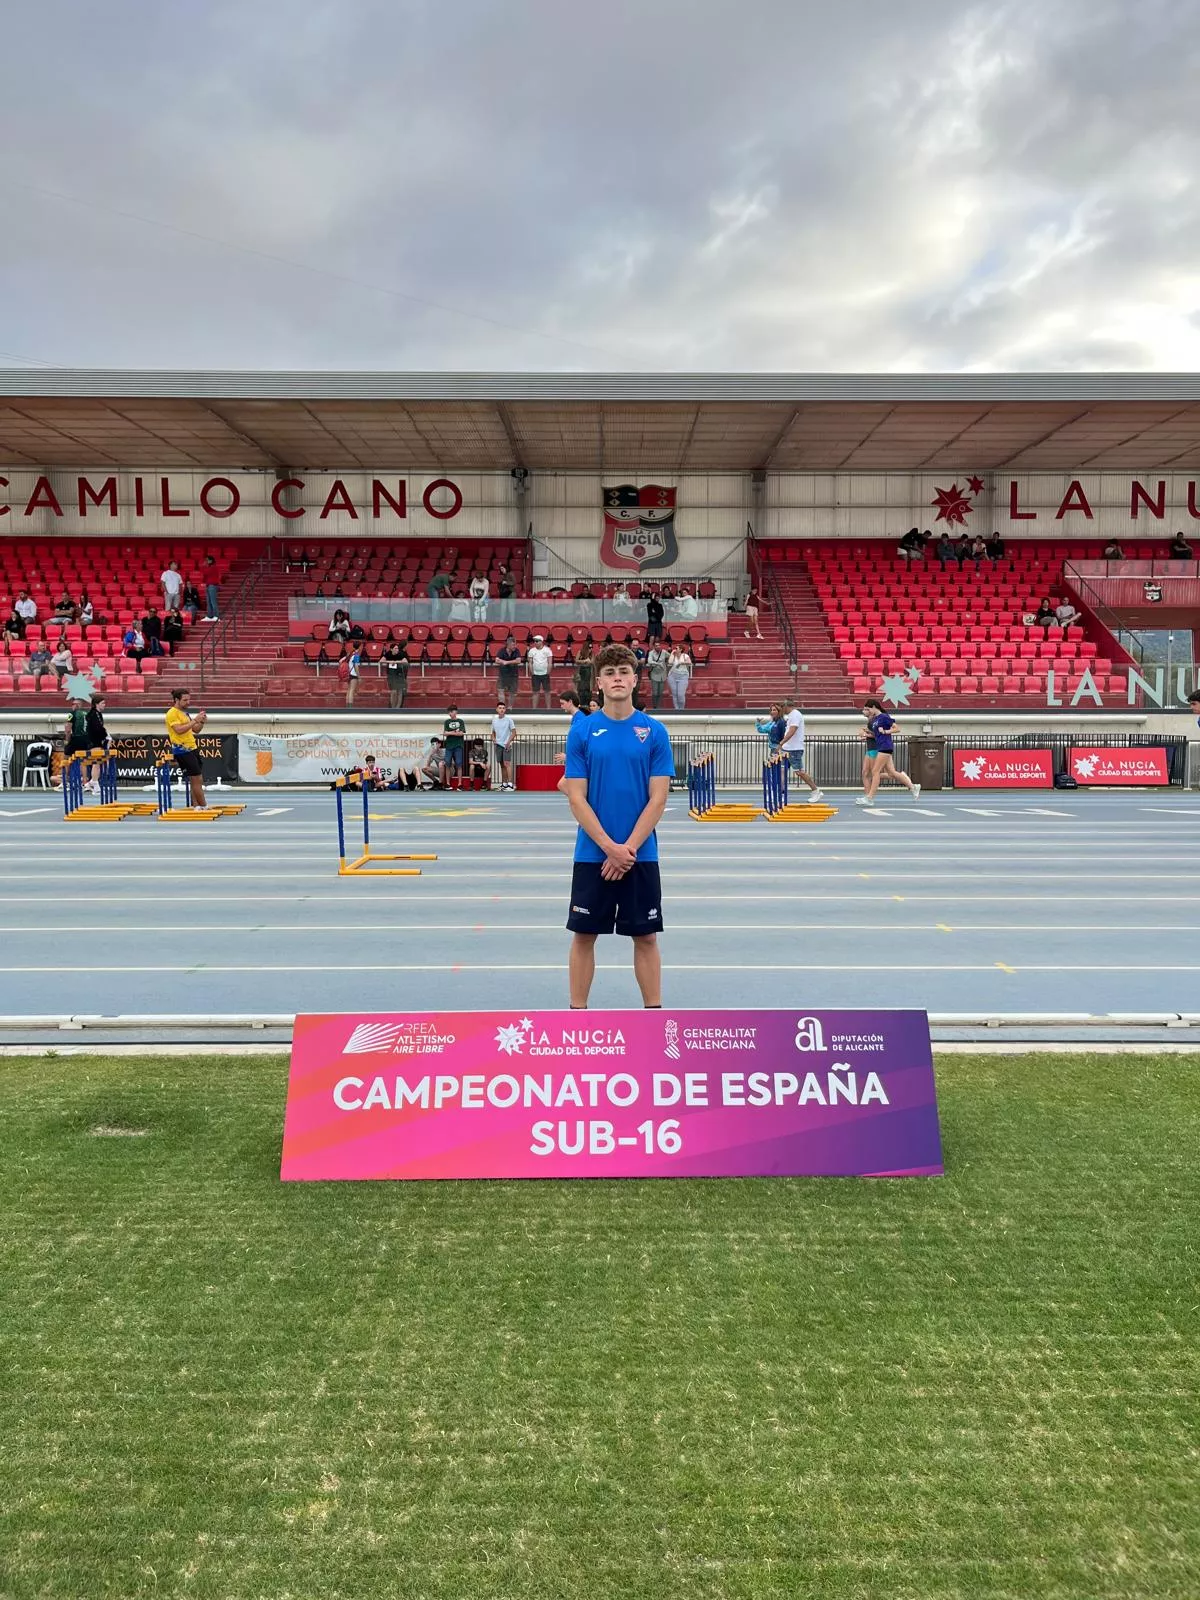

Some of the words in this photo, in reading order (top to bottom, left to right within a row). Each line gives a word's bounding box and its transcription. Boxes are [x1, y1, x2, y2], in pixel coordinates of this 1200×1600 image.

[271, 477, 463, 520] CANO
[1010, 480, 1094, 520] LA
[1047, 667, 1103, 706] LA
[287, 749, 351, 759] COMUNITAT
[356, 749, 425, 759] VALENCIANA
[988, 762, 1000, 772] LA
[1102, 760, 1114, 770] LA
[1020, 771, 1047, 779] DEPORTE
[1134, 769, 1161, 777] DEPORTE
[403, 1023, 437, 1034] RFEA
[683, 1027, 757, 1039] GENERALITAT
[397, 1034, 456, 1044] ATLETISMO
[529, 1029, 550, 1045] LA
[831, 1033, 884, 1043] DIPUTACIÓN
[392, 1044, 414, 1054] AIRE
[416, 1044, 444, 1053] LIBRE
[684, 1039, 757, 1051] VALENCIANA
[845, 1044, 885, 1052] ALICANTE
[529, 1046, 563, 1056] CIUDAD
[565, 1046, 582, 1056] DEL
[584, 1046, 626, 1055] DEPORTE
[333, 1072, 640, 1111] CAMPEONATO
[652, 1072, 709, 1107] DE
[721, 1062, 890, 1106] ESPAÑA
[529, 1118, 683, 1156] SUB-16
